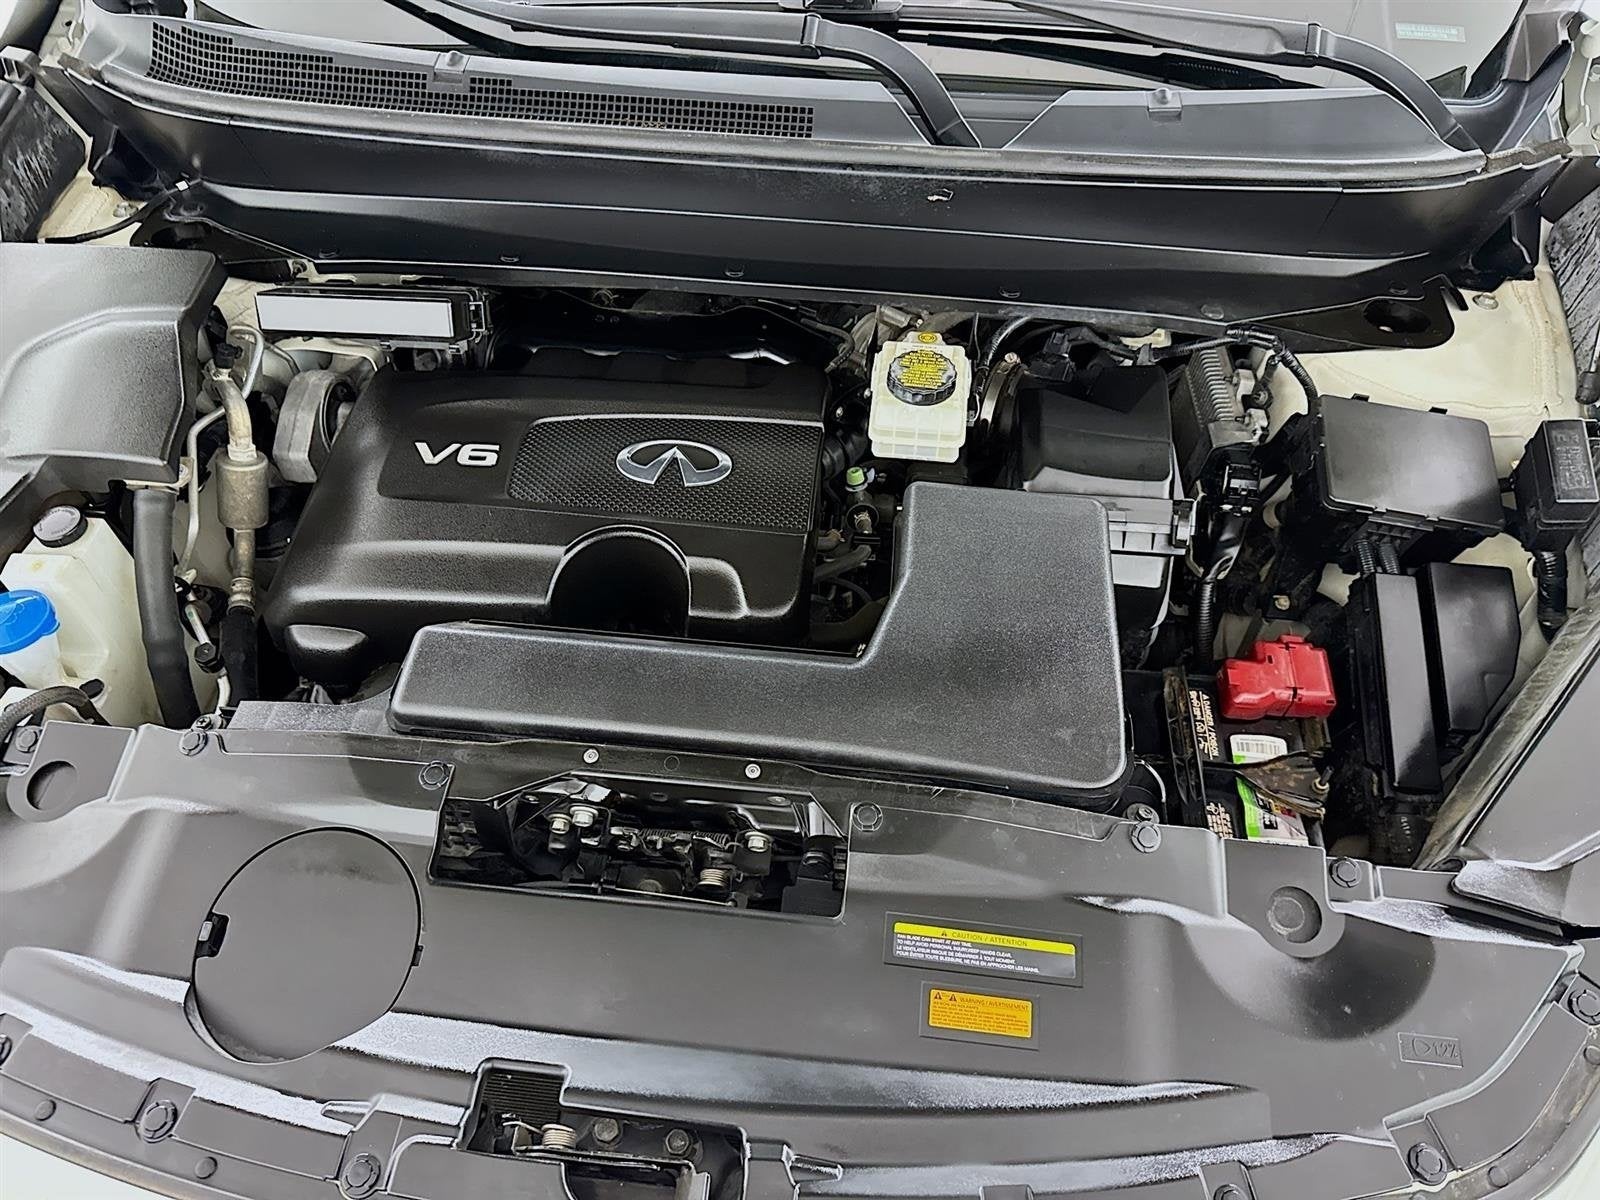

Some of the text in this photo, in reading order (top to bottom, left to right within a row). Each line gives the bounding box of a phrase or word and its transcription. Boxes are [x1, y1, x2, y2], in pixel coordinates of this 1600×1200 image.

[415, 442, 500, 467] V6
[1204, 701, 1214, 726] DANGER
[1209, 732, 1219, 757] POISON
[951, 931, 982, 941] CAUTION
[989, 936, 1027, 947] ATTENTION
